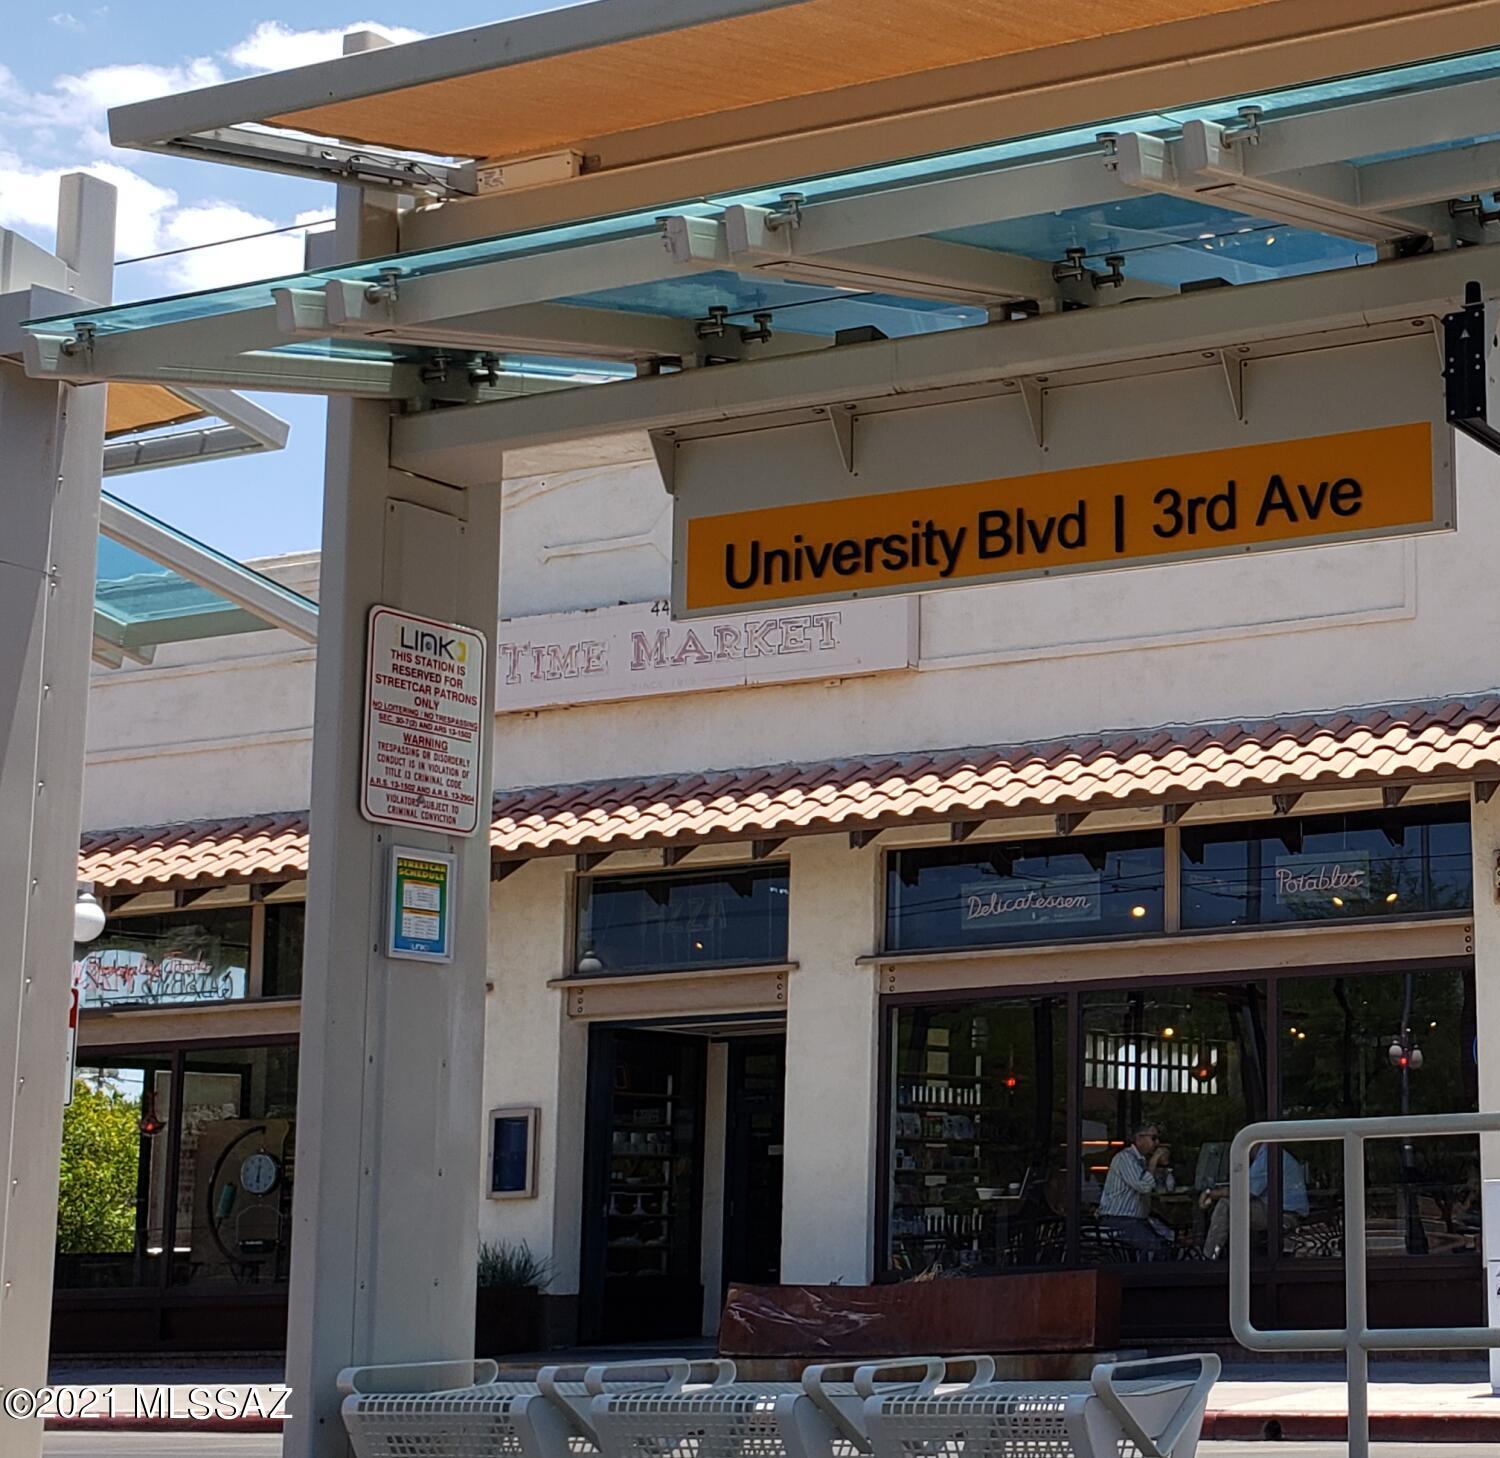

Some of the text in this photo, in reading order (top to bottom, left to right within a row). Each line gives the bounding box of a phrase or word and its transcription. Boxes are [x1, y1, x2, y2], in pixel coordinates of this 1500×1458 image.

[725, 520, 967, 589] University
[977, 500, 1087, 560] Blvd
[1153, 480, 1238, 539] 3rd
[1255, 475, 1362, 526] Ave
[651, 600, 670, 616] 44
[499, 611, 841, 685] TIME MARKET
[391, 649, 466, 676] THIS STATION IS
[392, 663, 463, 689] RESERVED FOR
[375, 673, 477, 706] STREETCAR PATRONS
[372, 700, 382, 709] NO
[383, 704, 419, 717] LOITERING
[424, 712, 434, 720] NO
[436, 714, 478, 730] TRESPASSING
[414, 696, 440, 711] ONLY
[378, 713, 394, 722] SEC.
[419, 721, 433, 731] AND
[434, 726, 447, 734] ARS
[377, 741, 470, 767] TRESPASSING OR DISORDERLY
[403, 732, 448, 751] WARNING
[377, 753, 470, 779] CONDUCT IS IN VIOLATION OF
[385, 766, 462, 790] TITLE 13 CRIMINAL CODE
[417, 785, 430, 794] AND
[386, 794, 459, 815] VIOLATORS SUBJECT TO
[387, 805, 457, 825] CRIMINAL CONVICTION
[398, 859, 446, 872] STREETCAR
[399, 868, 445, 880] SCHEDULE
[1276, 864, 1365, 894] Potables
[967, 891, 1091, 920] Delicatessen
